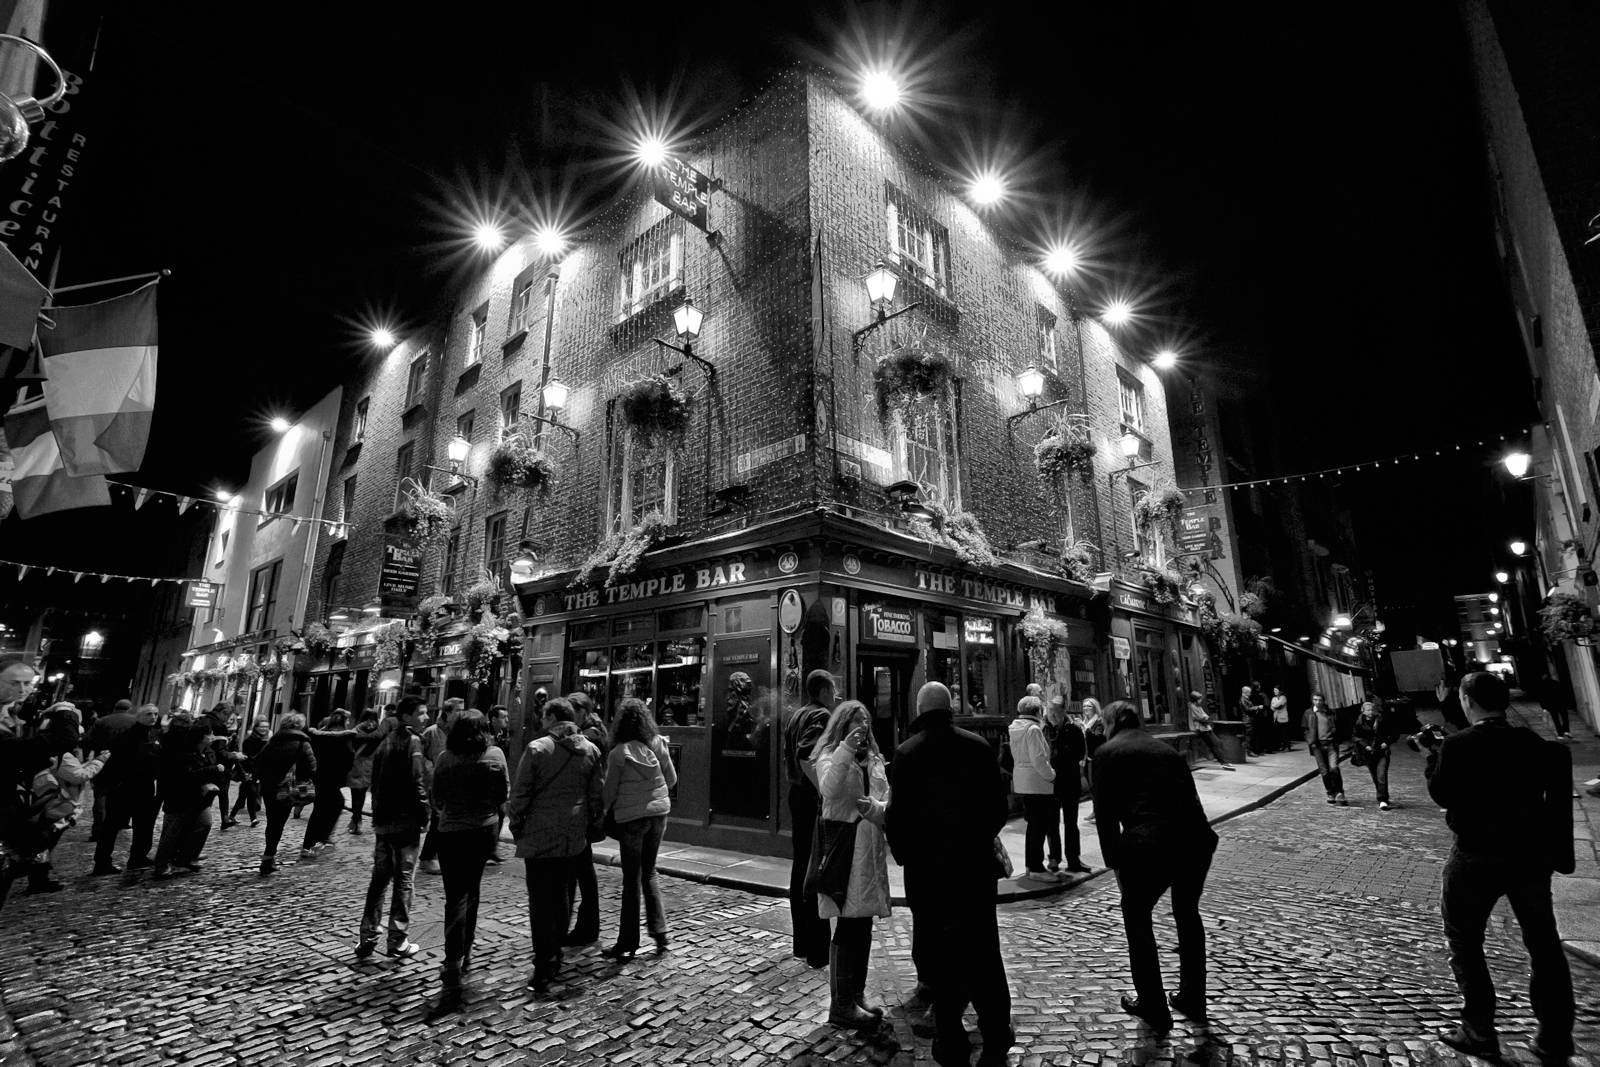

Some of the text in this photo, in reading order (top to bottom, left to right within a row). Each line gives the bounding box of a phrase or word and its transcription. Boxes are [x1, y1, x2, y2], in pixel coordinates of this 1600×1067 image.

[0, 68, 84, 247] Bottice
[674, 158, 698, 184] THE
[24, 133, 87, 270] RESTAURAN
[662, 166, 708, 206] TEMPLE
[672, 190, 697, 216] BAR
[1209, 516, 1226, 560] BAR
[781, 556, 795, 569] 48
[846, 558, 858, 570] 48
[397, 583, 415, 591] MUSIC
[564, 562, 746, 611] THE TEMPLE BAR
[915, 569, 955, 594] THE
[961, 578, 1025, 607] TEMPLE
[1030, 588, 1057, 613] BAR
[869, 613, 912, 637] TOBACCO
